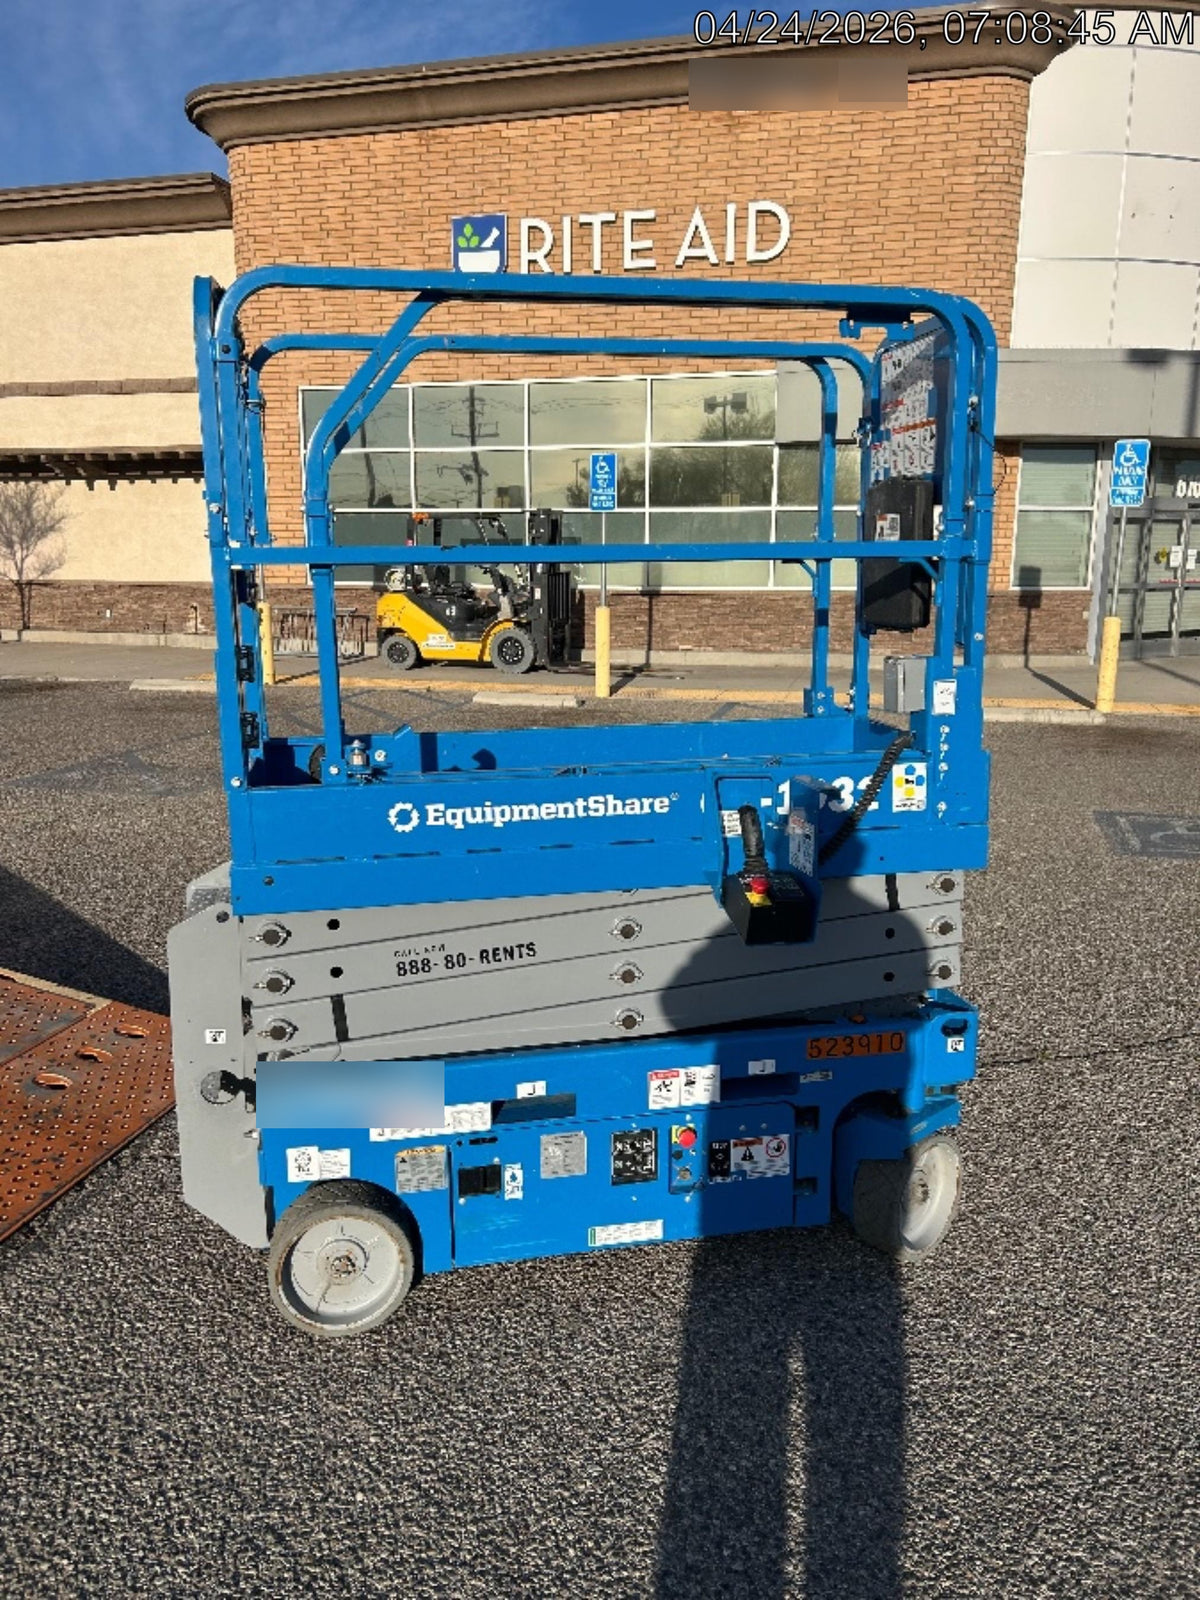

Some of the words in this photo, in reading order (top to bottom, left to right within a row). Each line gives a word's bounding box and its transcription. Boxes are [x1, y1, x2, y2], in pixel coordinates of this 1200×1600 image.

[519, 208, 657, 276] RITE
[675, 199, 792, 269] AID
[425, 793, 671, 830] EquipmentShare
[808, 1032, 905, 1059] 523910
